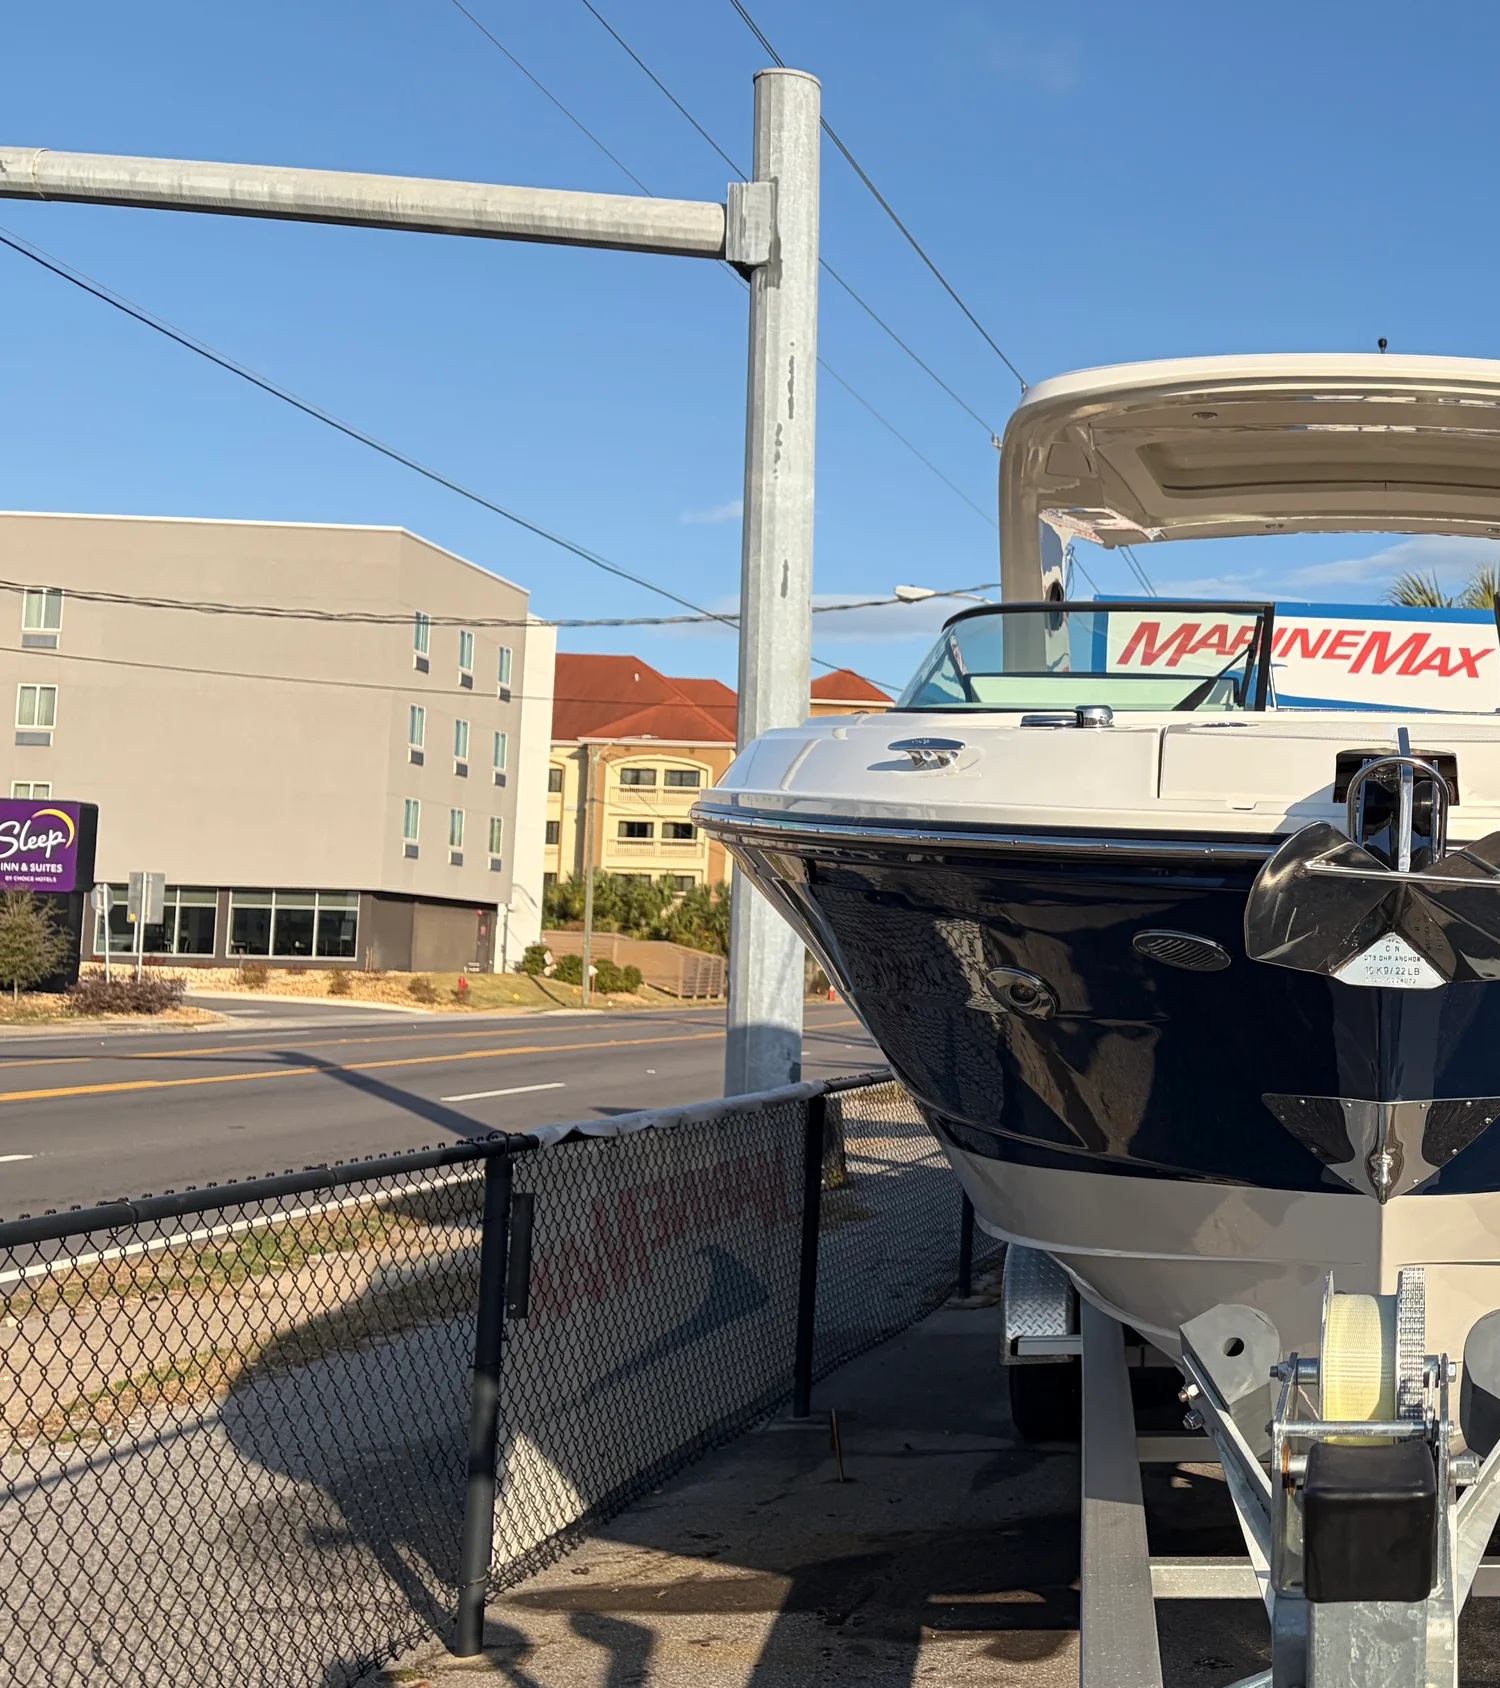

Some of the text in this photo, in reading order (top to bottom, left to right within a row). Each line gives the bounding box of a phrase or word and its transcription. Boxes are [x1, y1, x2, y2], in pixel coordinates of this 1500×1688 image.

[0, 819, 66, 859] Sleep
[0, 862, 63, 873] INN & SUITES
